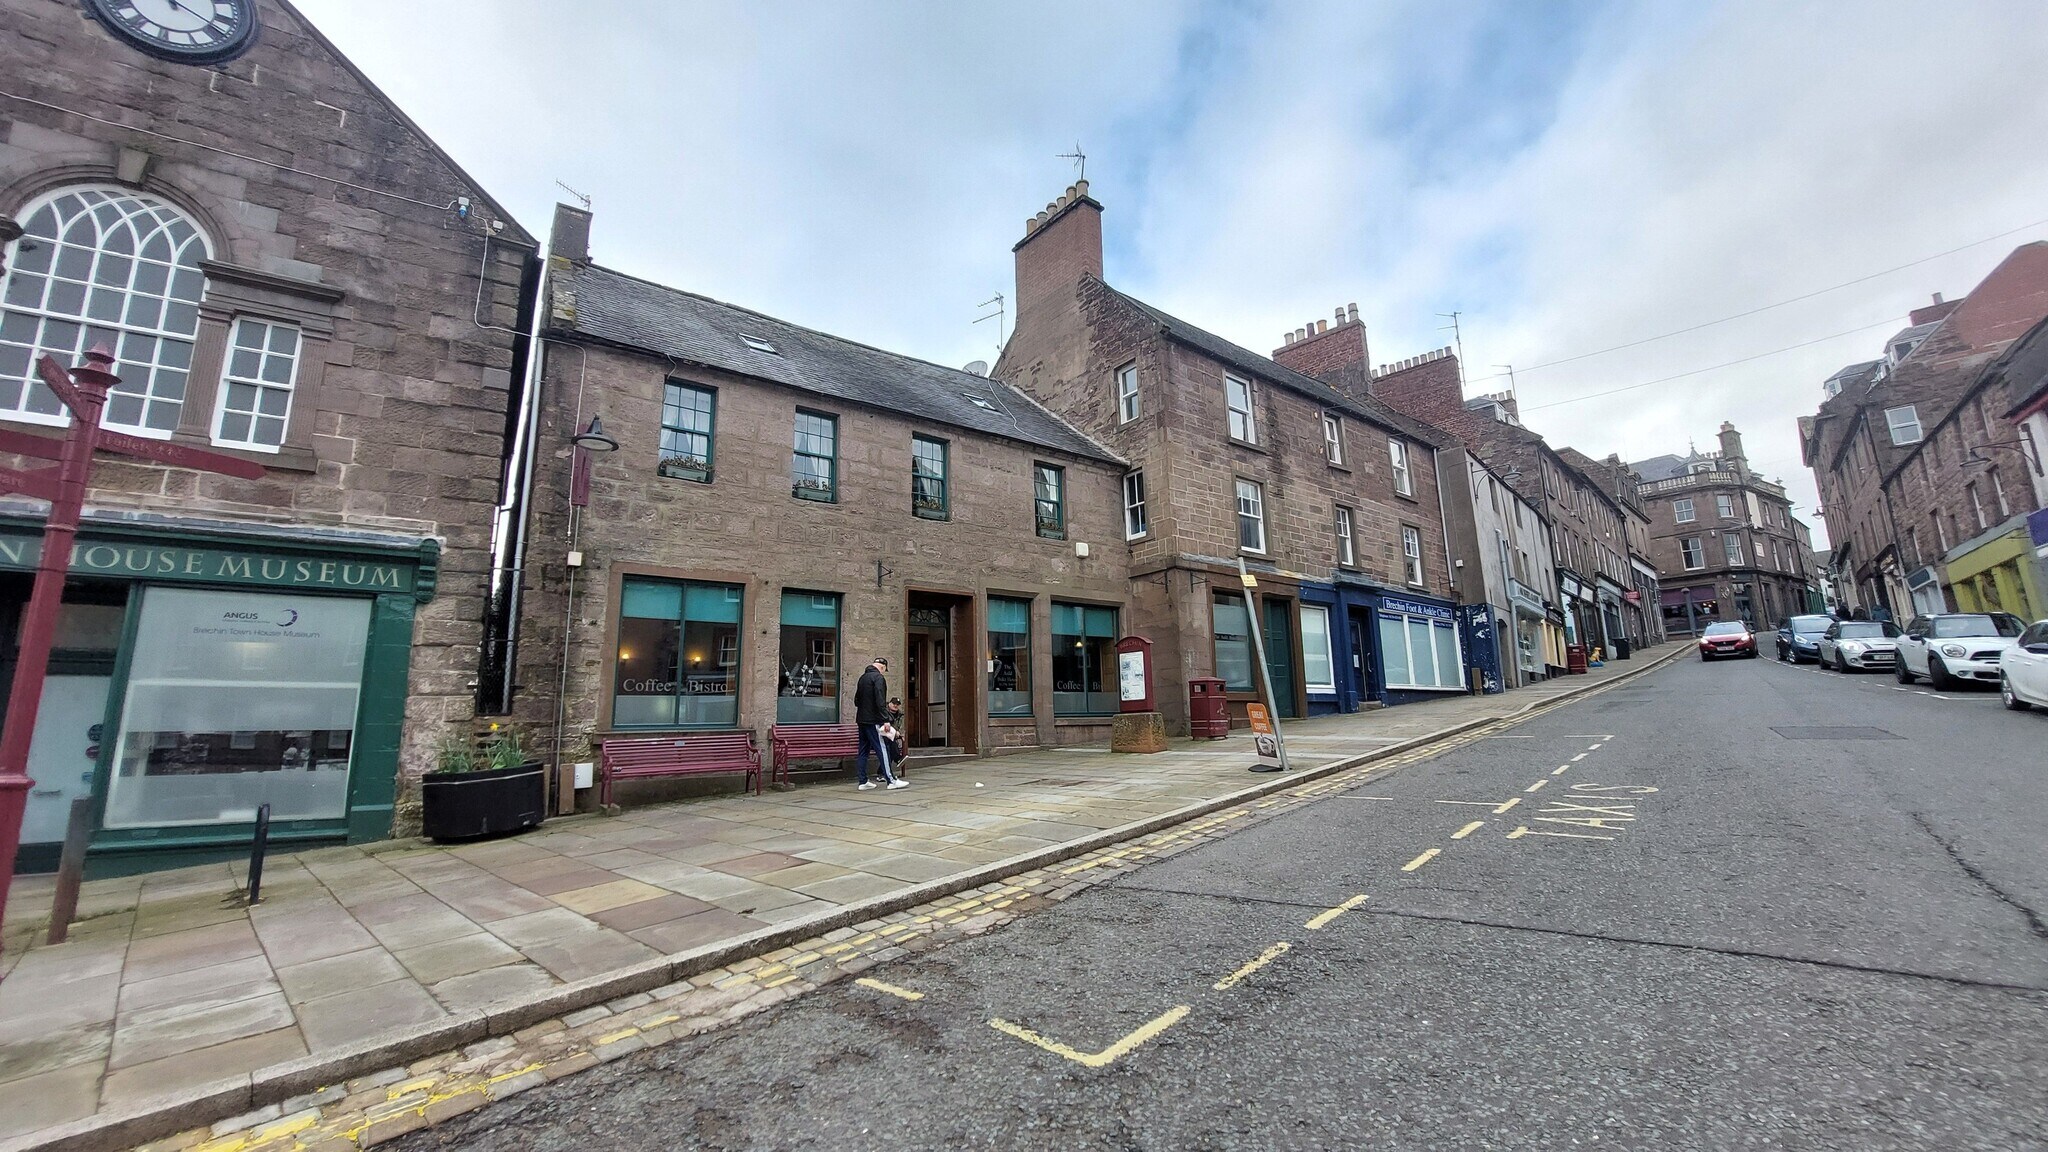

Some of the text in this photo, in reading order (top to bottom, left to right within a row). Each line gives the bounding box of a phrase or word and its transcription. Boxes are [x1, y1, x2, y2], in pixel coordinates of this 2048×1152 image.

[215, 555, 400, 588] MUSEUM
[223, 611, 259, 620] ANGUS
[1385, 600, 1405, 611] Brechin
[1406, 603, 1417, 613] Foot
[1423, 607, 1437, 617] Ankle
[1437, 608, 1450, 619] Clinic
[229, 628, 252, 636] Town
[254, 629, 281, 637] House
[283, 630, 320, 638] Museum
[623, 678, 728, 693] Coffee Bistro
[1057, 681, 1081, 690] Coffee
[1505, 783, 1660, 840] TAXIS
